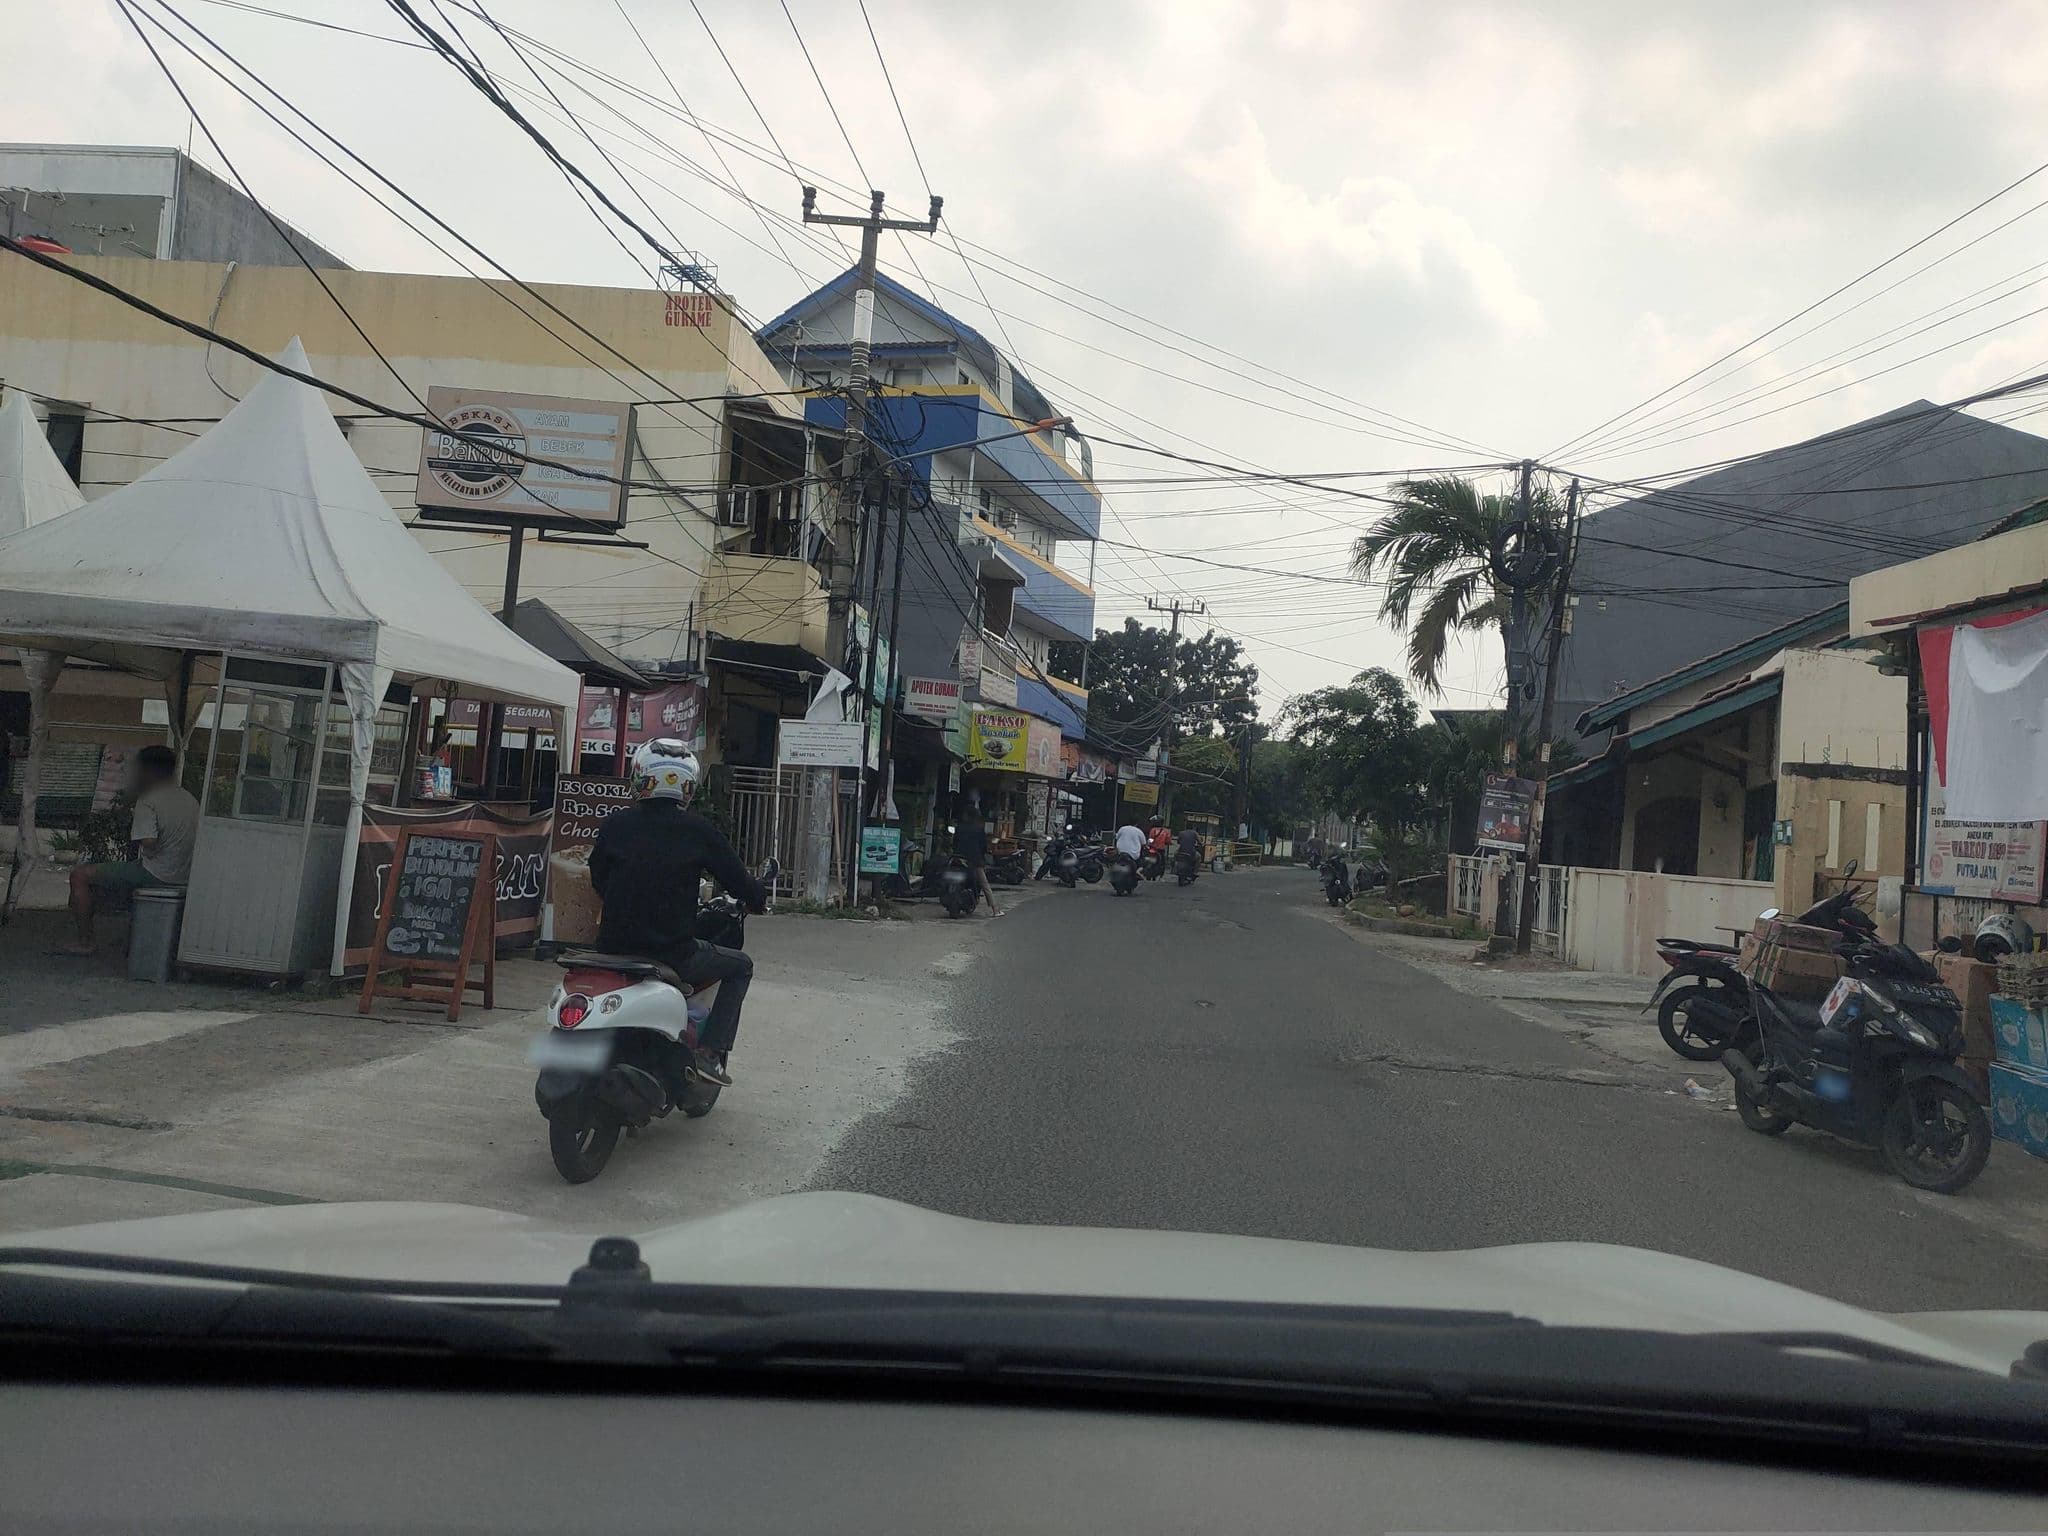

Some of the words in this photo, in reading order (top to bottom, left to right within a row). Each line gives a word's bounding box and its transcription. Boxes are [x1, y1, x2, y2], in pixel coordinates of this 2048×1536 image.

[665, 296, 712, 310] APOTEK
[665, 311, 712, 327] GURAME
[449, 411, 512, 431] BEKASI
[535, 413, 569, 428] AYAM
[440, 472, 480, 496] KELEZATAN
[974, 713, 1026, 729] BAKSO
[559, 780, 582, 794] ES
[562, 799, 594, 817] Rp.
[408, 836, 484, 861] PERFECT
[405, 856, 481, 878] BUNDLING
[1957, 864, 1978, 879] PUTRA
[1980, 866, 1997, 881] JAYA
